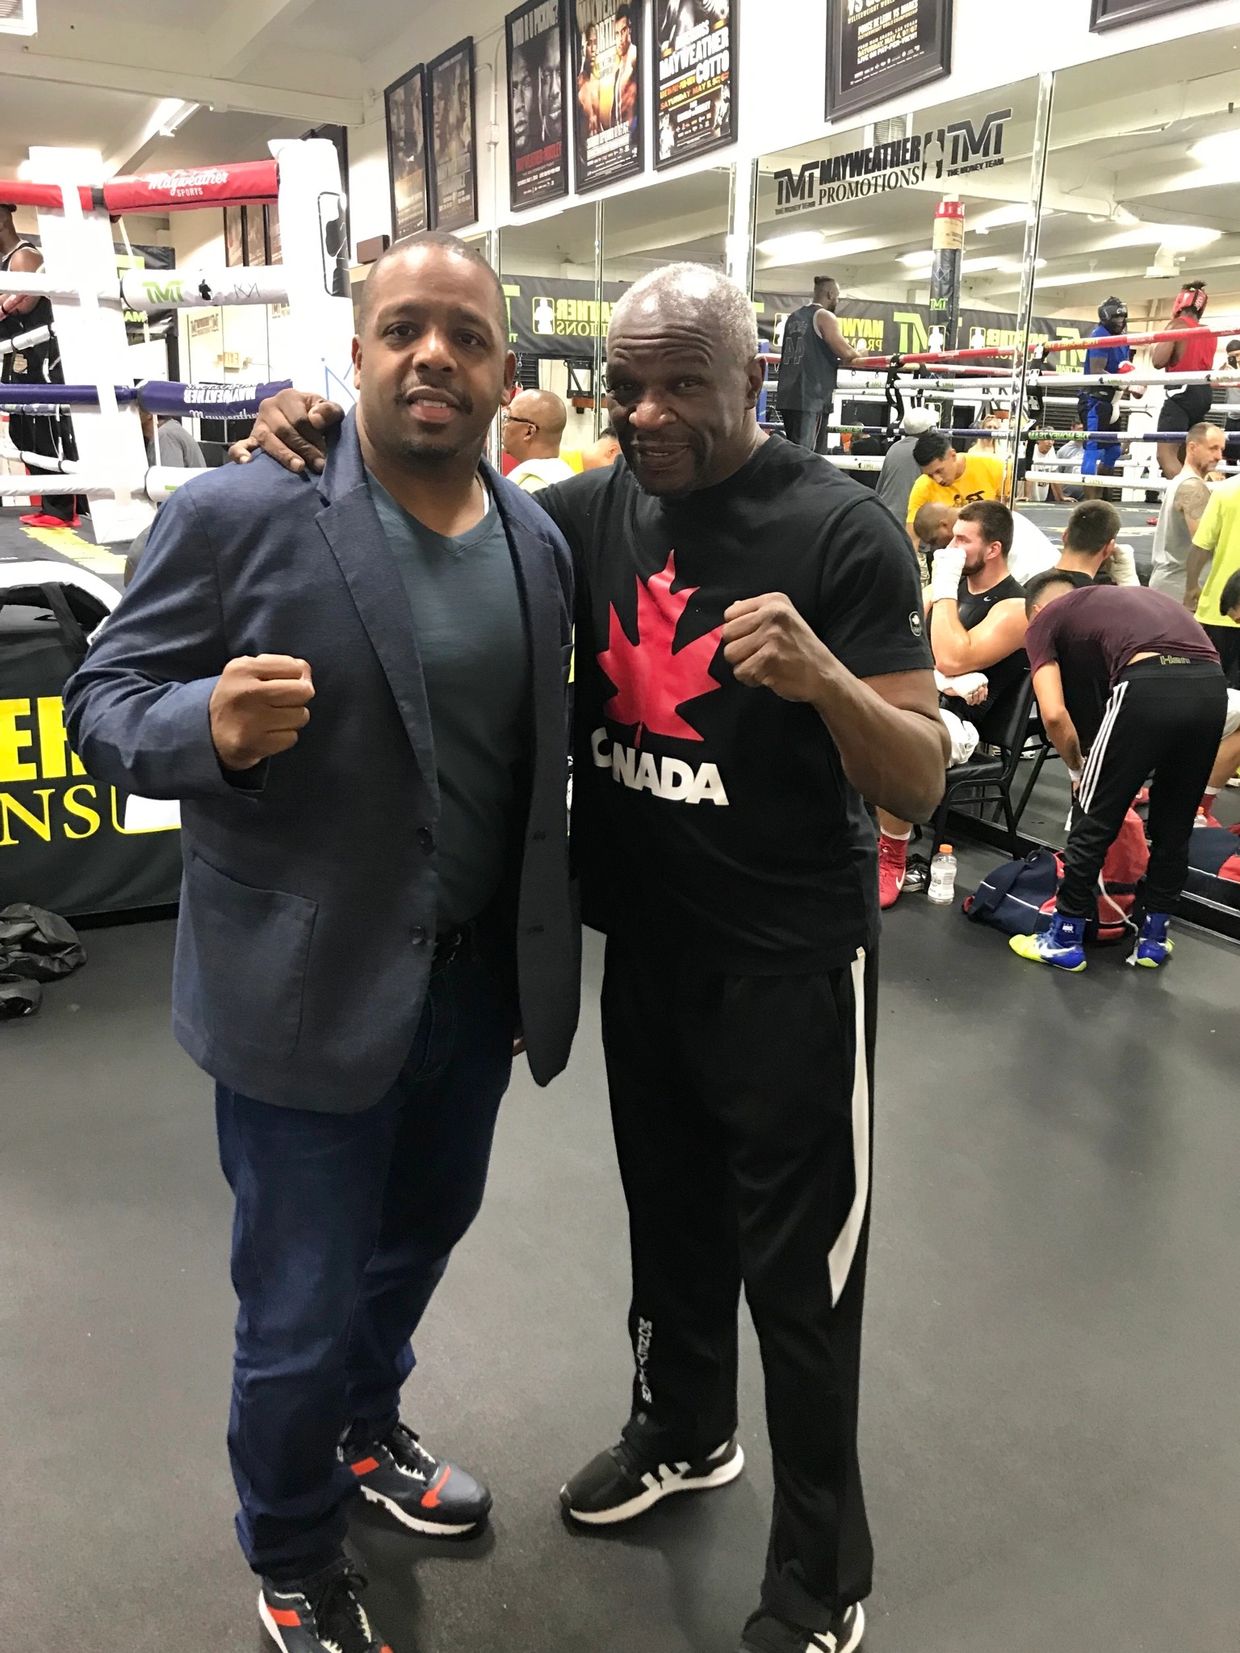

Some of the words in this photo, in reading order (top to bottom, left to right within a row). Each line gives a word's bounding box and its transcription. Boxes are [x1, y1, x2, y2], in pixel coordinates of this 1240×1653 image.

[660, 26, 729, 81] MAYWEATHER
[696, 49, 730, 84] COTTO
[947, 108, 1012, 165] TMT
[147, 168, 229, 197] Mayweather
[819, 135, 921, 186] MAYWEATHER
[176, 187, 204, 197] SPORTS
[774, 161, 819, 206] TMT
[818, 165, 920, 206] PROMOTIONS
[591, 727, 729, 806] CNADA
